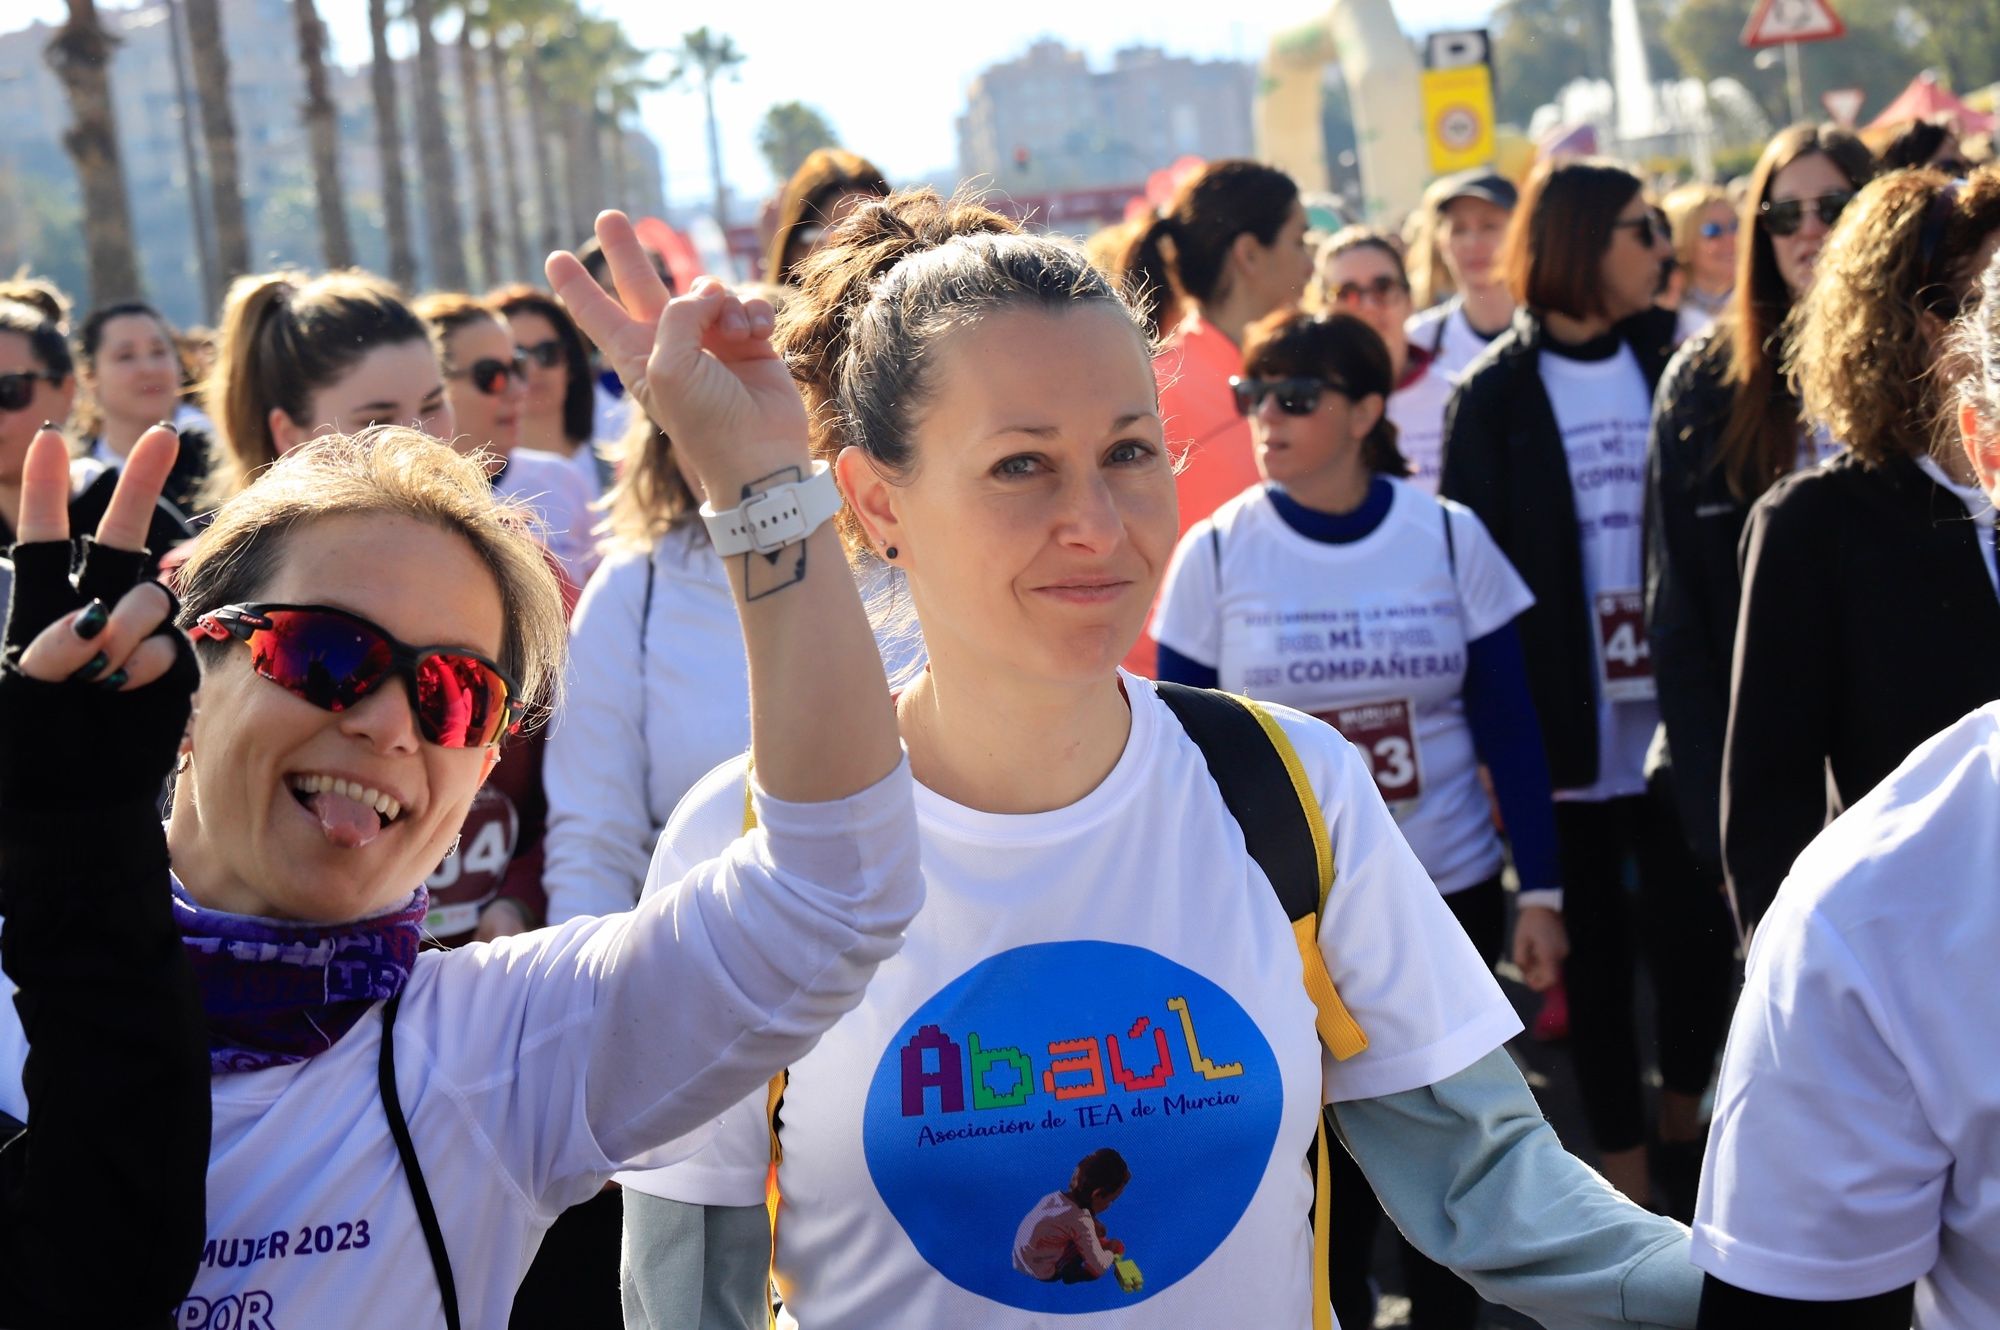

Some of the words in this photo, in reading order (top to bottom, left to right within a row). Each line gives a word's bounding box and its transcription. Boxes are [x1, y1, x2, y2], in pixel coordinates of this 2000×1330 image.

[1329, 624, 1362, 649] MÍ
[1357, 735, 1415, 788] 3
[917, 1116, 1035, 1148] Asociación
[1041, 1114, 1067, 1130] de
[1073, 1103, 1124, 1129] TEA
[1130, 1102, 1156, 1118] de
[1163, 1091, 1240, 1116] Murcia
[201, 1230, 290, 1268] MUJER
[294, 1219, 371, 1255] 2023
[177, 1290, 276, 1330] POR
